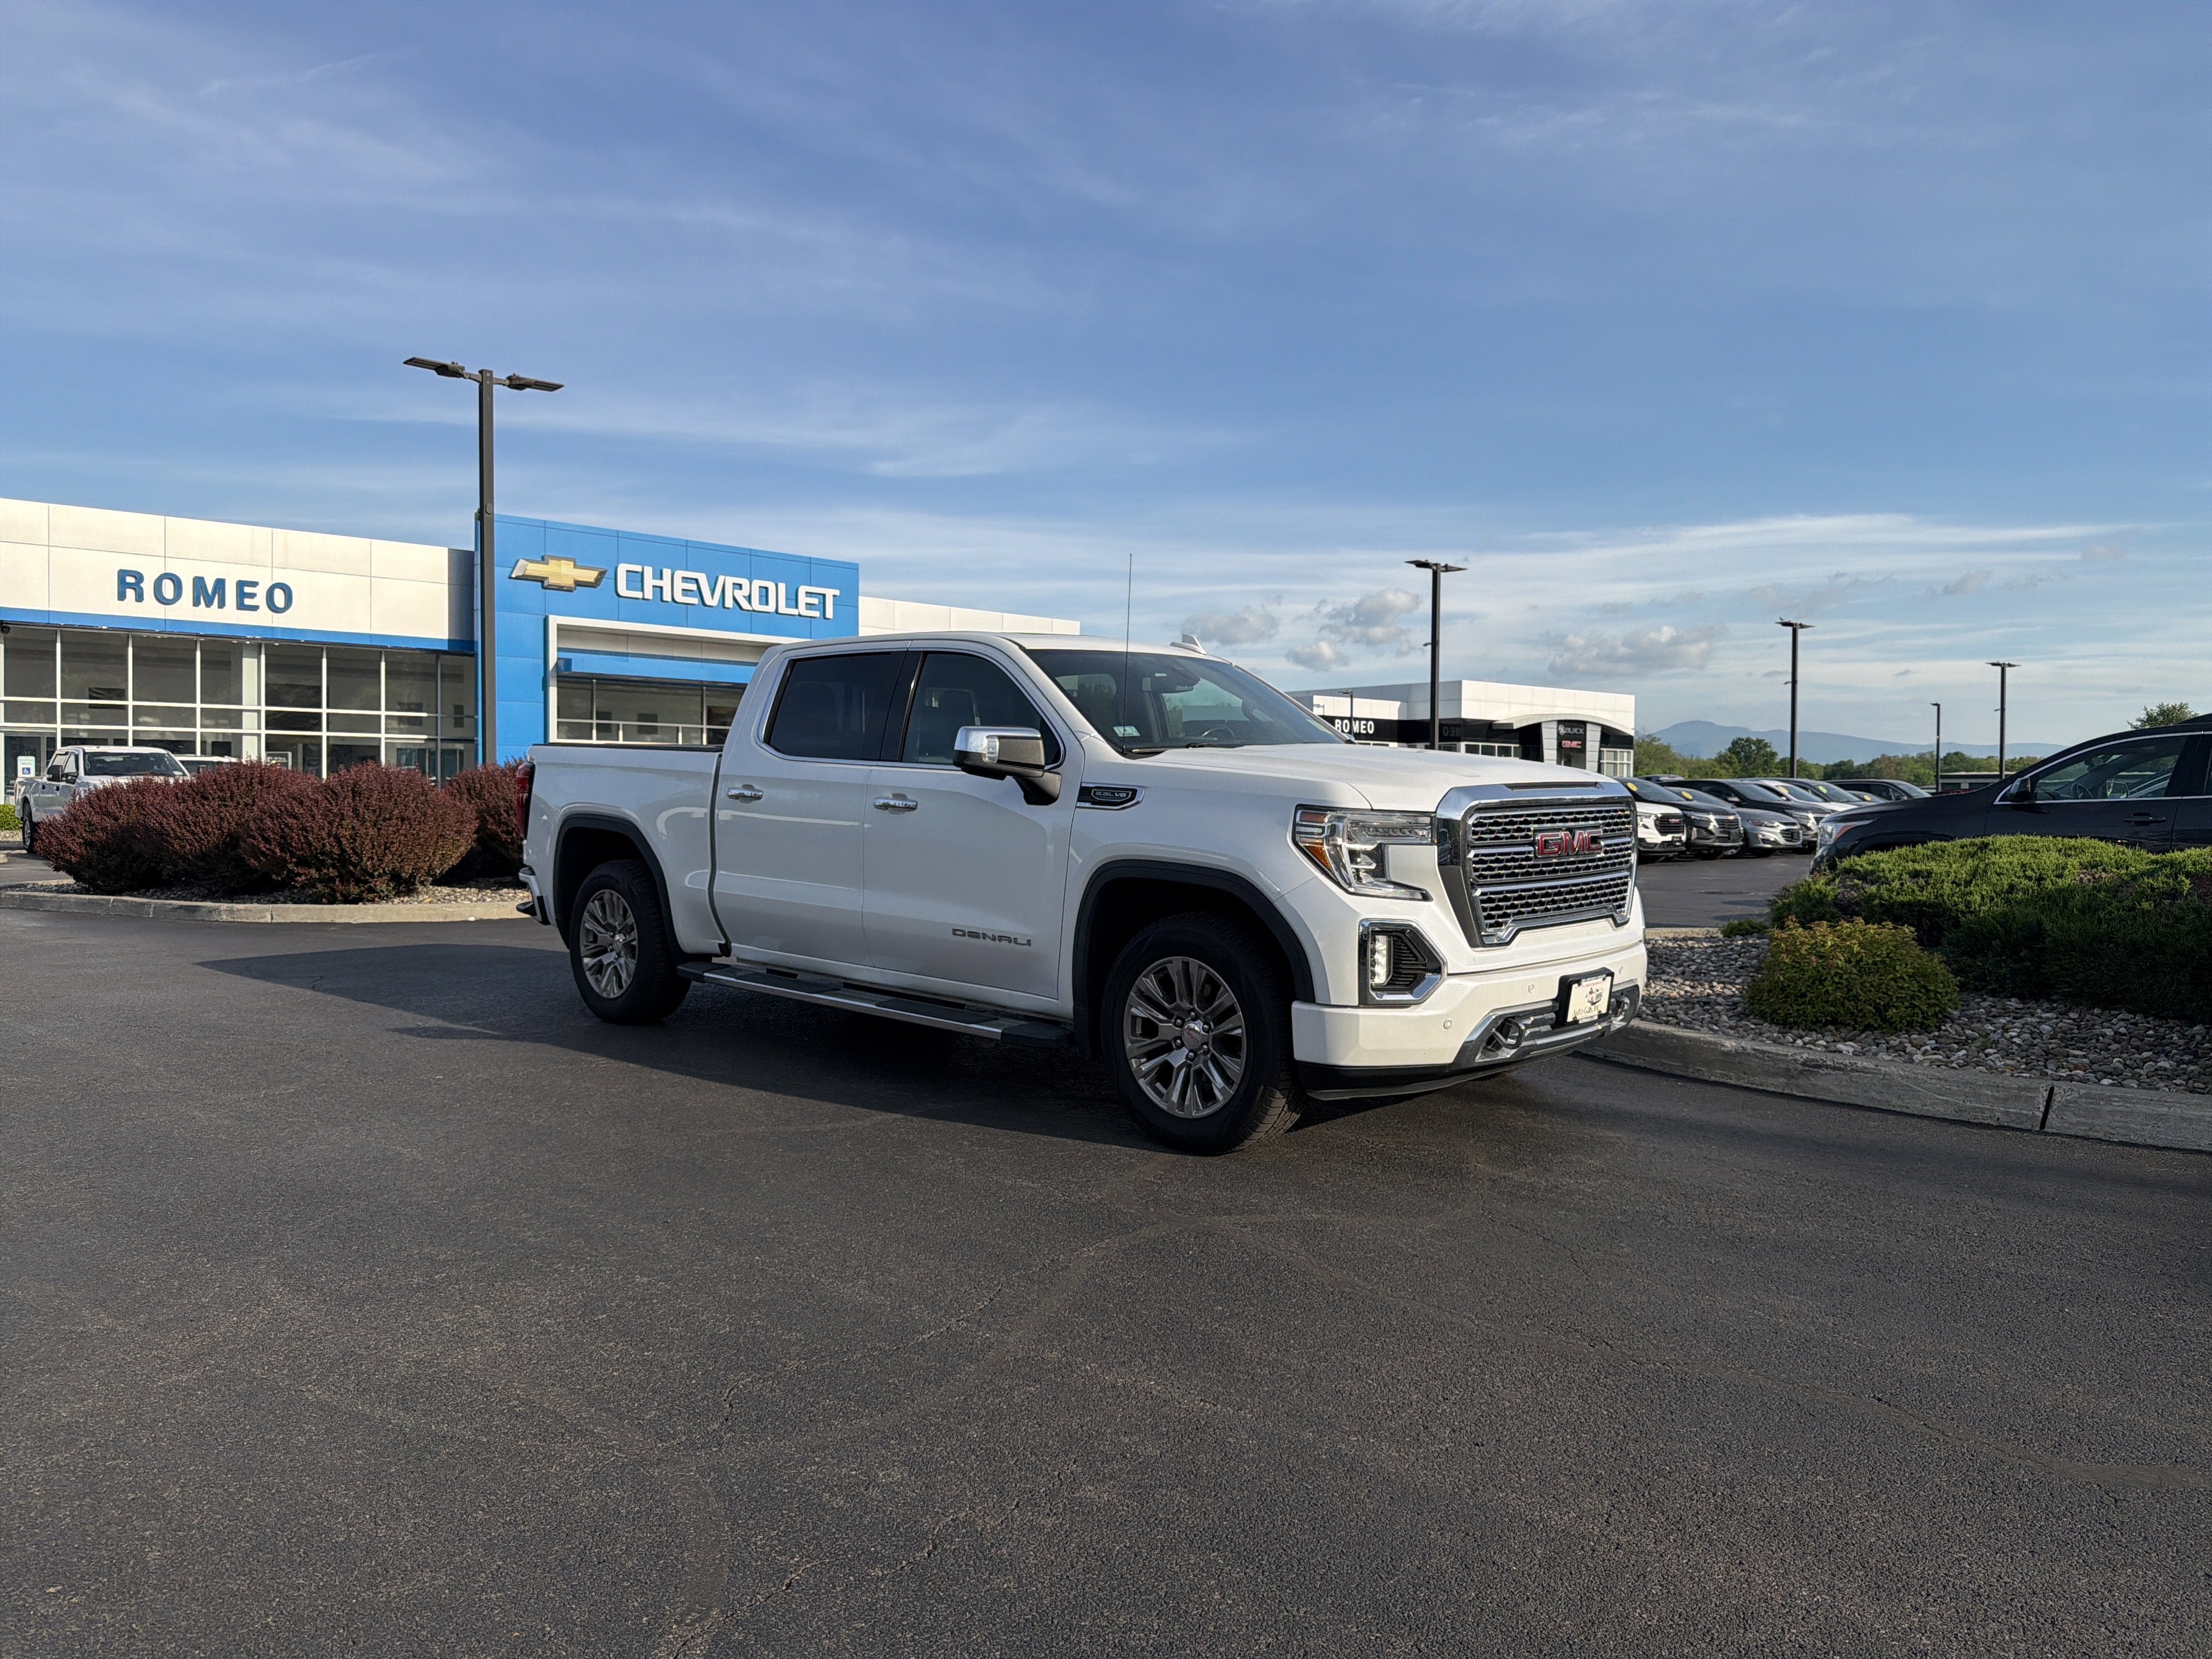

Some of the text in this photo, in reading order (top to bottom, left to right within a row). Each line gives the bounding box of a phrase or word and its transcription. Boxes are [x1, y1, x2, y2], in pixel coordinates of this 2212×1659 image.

[117, 569, 294, 614] ROMEO
[616, 563, 840, 619] CHEVROLET
[1335, 719, 1374, 734] ROMEO
[1561, 740, 1582, 748] GMC
[1536, 828, 1603, 857] GMC
[952, 928, 1031, 947] DENALI
